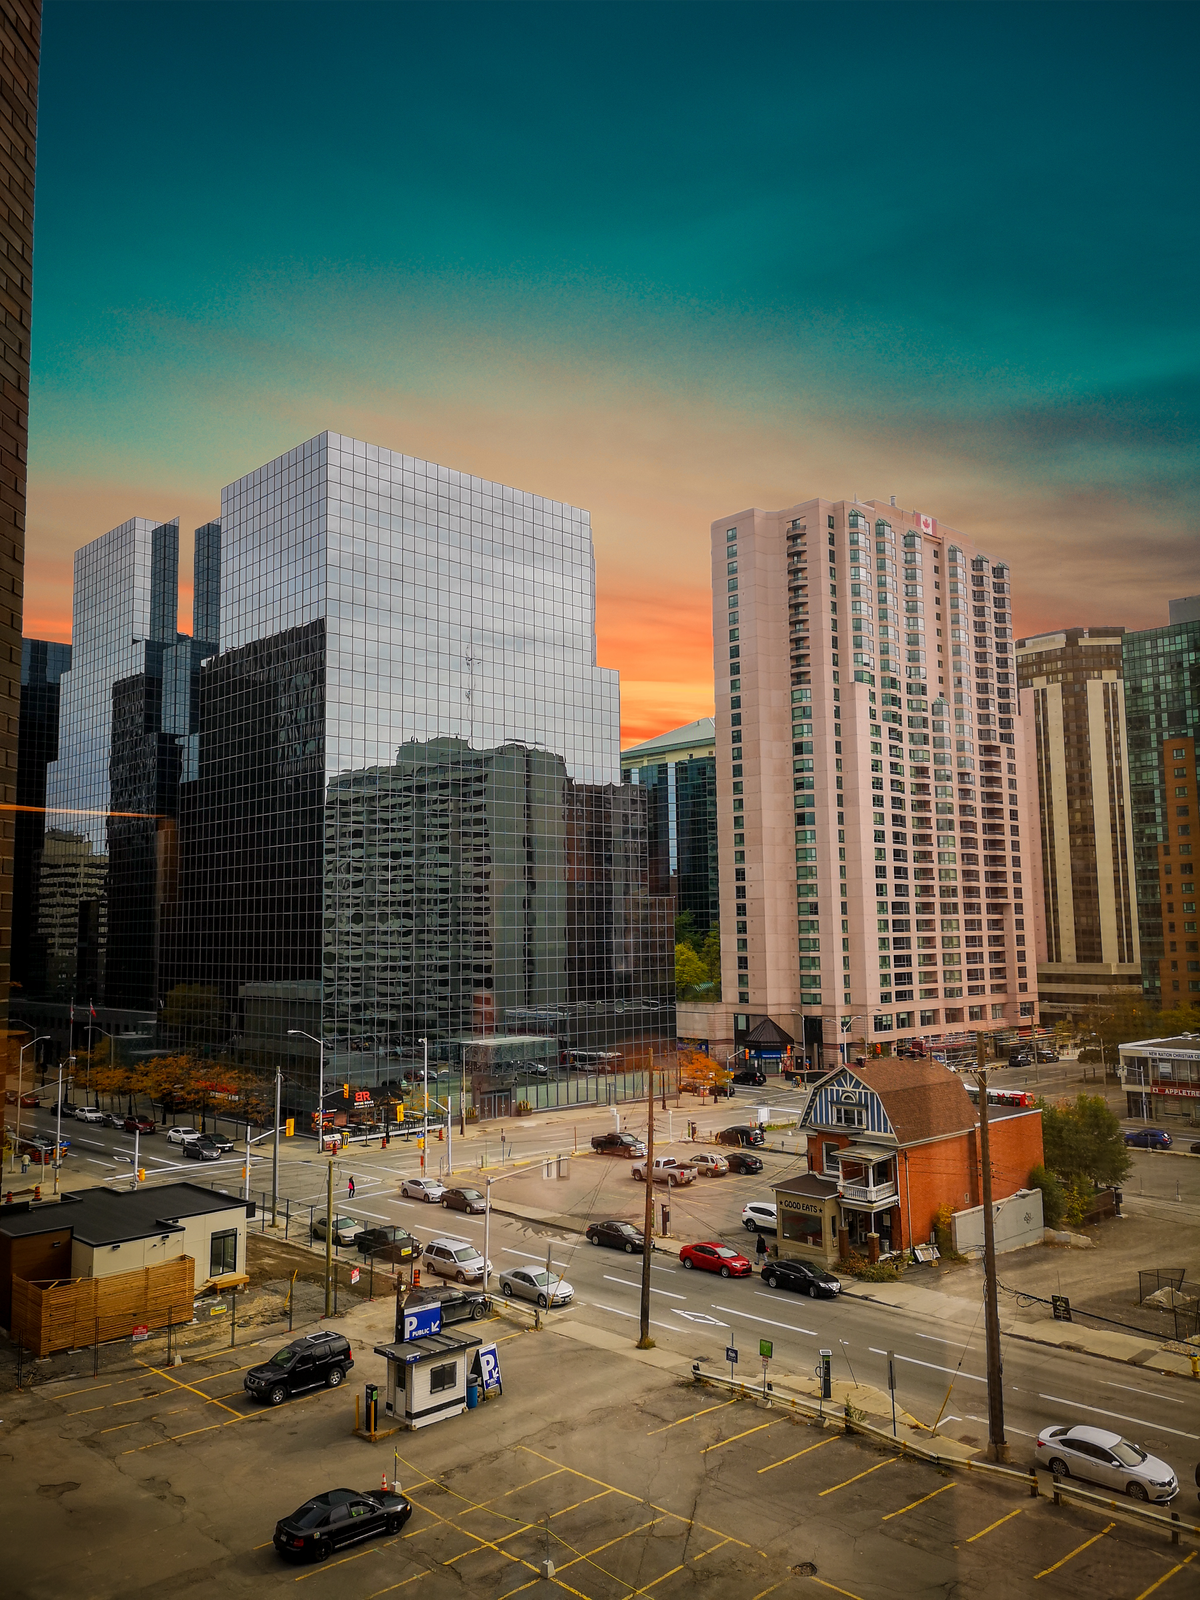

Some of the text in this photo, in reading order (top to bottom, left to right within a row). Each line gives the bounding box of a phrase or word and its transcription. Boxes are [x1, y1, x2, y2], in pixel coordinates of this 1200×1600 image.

[784, 1200, 817, 1213] GOOD EATS
[404, 1316, 418, 1339] P
[412, 1327, 430, 1338] PUBLIC
[481, 1354, 495, 1381] P
